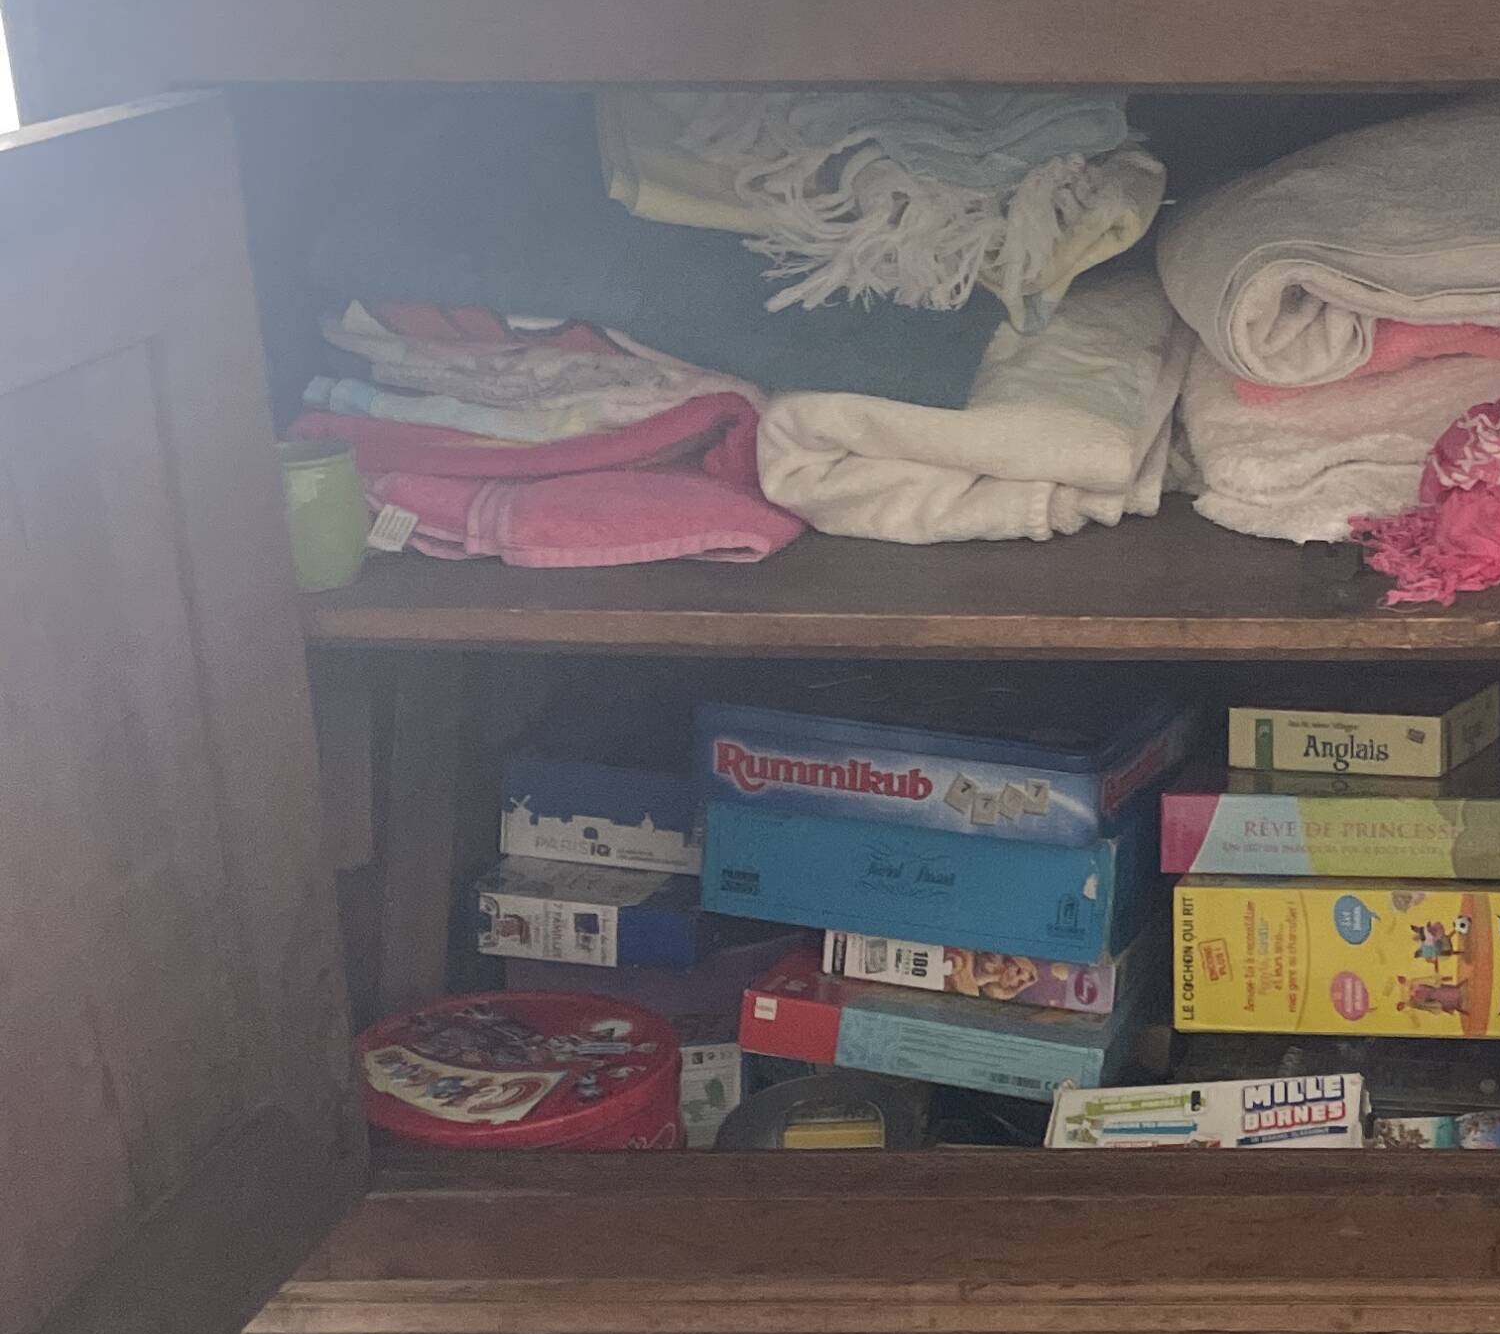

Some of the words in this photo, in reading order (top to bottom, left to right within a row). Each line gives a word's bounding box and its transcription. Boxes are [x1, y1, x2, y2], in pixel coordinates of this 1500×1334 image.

[1303, 734, 1389, 772] Anglais
[715, 740, 934, 801] Rummikub
[1244, 816, 1298, 838] RÊVE
[1305, 821, 1331, 838] DE
[1182, 896, 1195, 916] RIT
[1182, 919, 1196, 942] QUI
[911, 951, 929, 978] 100
[1182, 946, 1195, 1001] COCHON
[1182, 1007, 1195, 1021] LE
[1243, 1075, 1345, 1112] MILLE
[1241, 1102, 1347, 1134] BORNES
